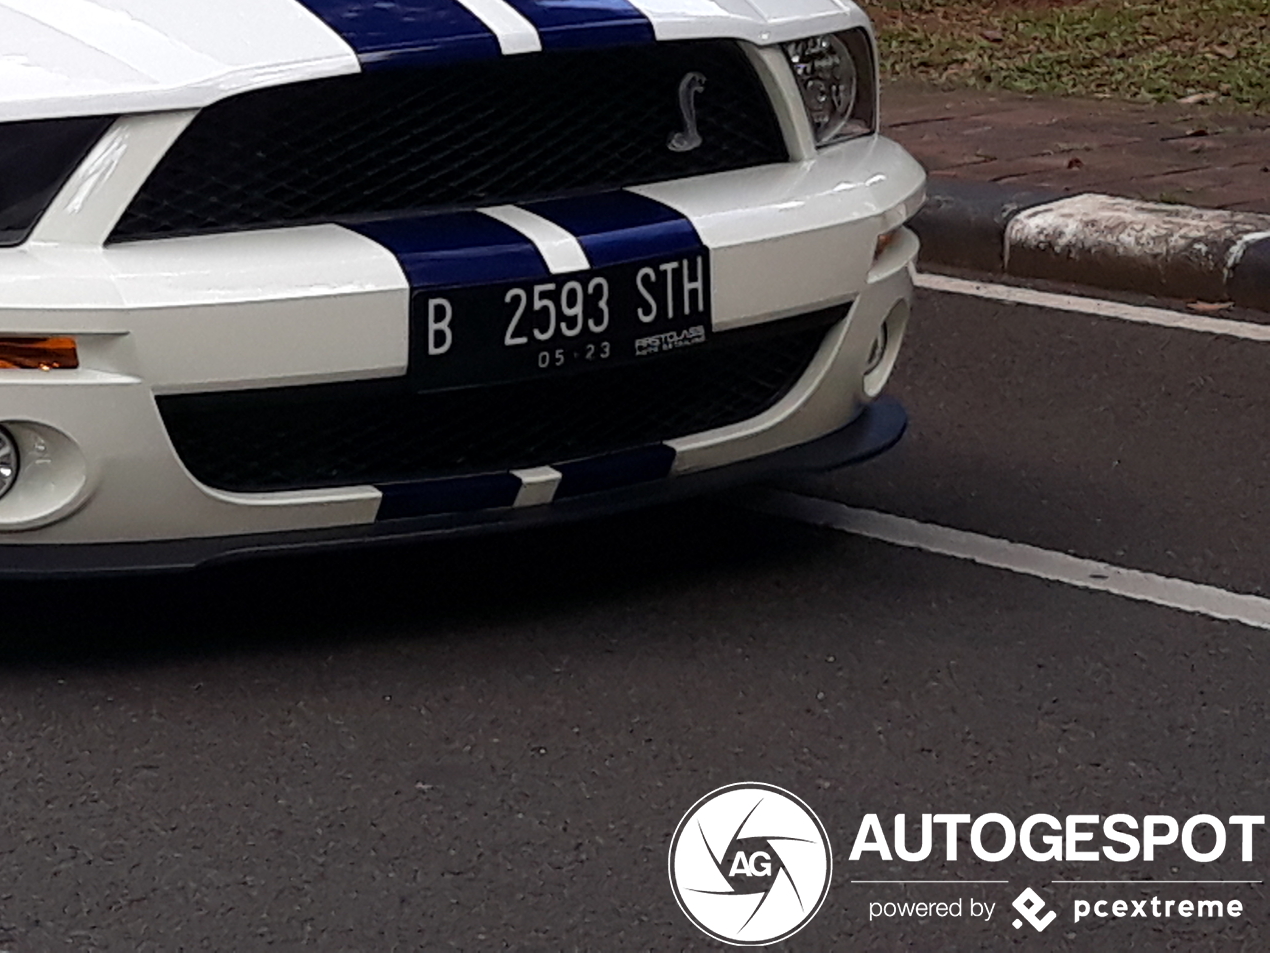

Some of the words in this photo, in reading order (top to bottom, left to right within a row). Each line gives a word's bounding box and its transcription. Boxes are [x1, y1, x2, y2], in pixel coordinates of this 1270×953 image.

[428, 297, 453, 356] B
[504, 277, 610, 347] 2593
[636, 255, 705, 324] STH
